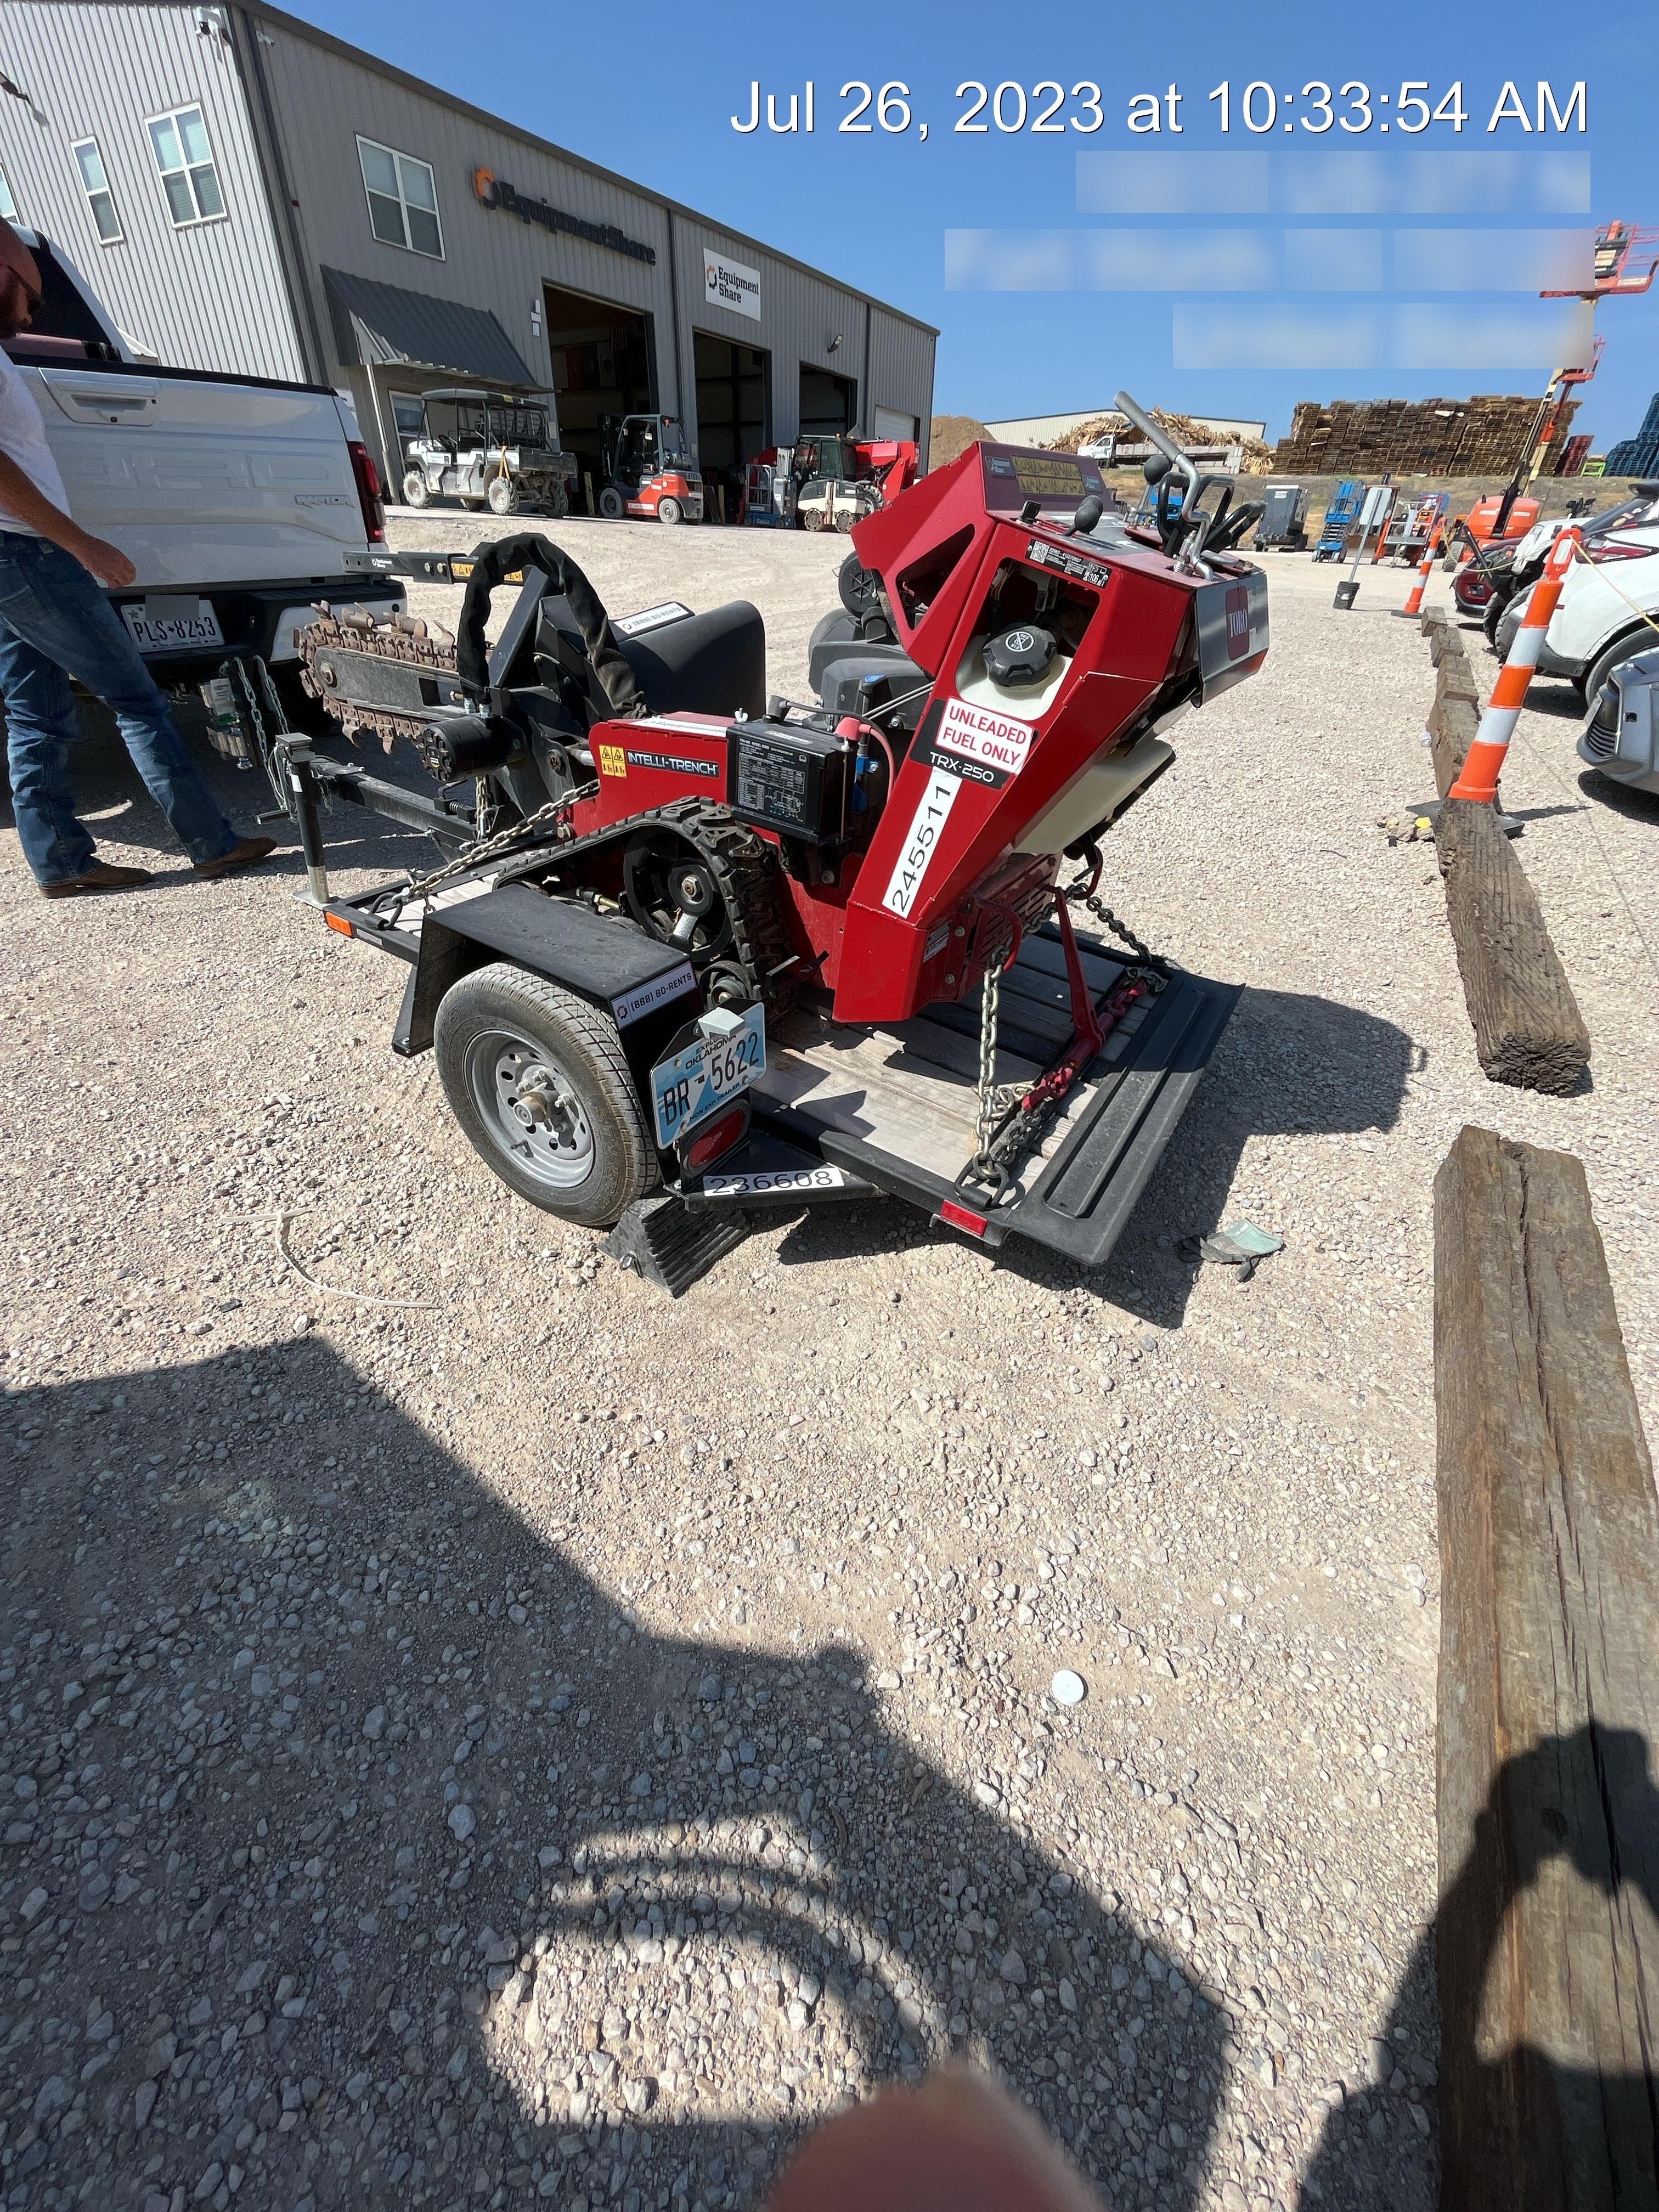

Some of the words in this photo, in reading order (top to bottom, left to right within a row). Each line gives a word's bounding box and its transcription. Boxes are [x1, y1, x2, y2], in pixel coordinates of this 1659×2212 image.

[500, 181, 656, 266] EquipmentShare
[718, 266, 759, 295] Equipment
[719, 283, 741, 303] Share
[1228, 608, 1248, 638] TORO
[949, 706, 1026, 744] UNLEADED
[627, 752, 716, 776] INTELLI-TRENCH
[943, 728, 977, 751] FUEL
[981, 741, 1021, 765] ONLY
[892, 785, 952, 913] 245511
[631, 992, 653, 1012] (888)
[655, 972, 692, 998] 80-RENTS
[663, 1077, 691, 1127] BR
[712, 1031, 759, 1091] 5622
[689, 1108, 703, 1121] NON
[704, 1101, 716, 1111] EXP
[716, 1082, 740, 1102] TRAILER
[709, 1171, 833, 1194] 236608
